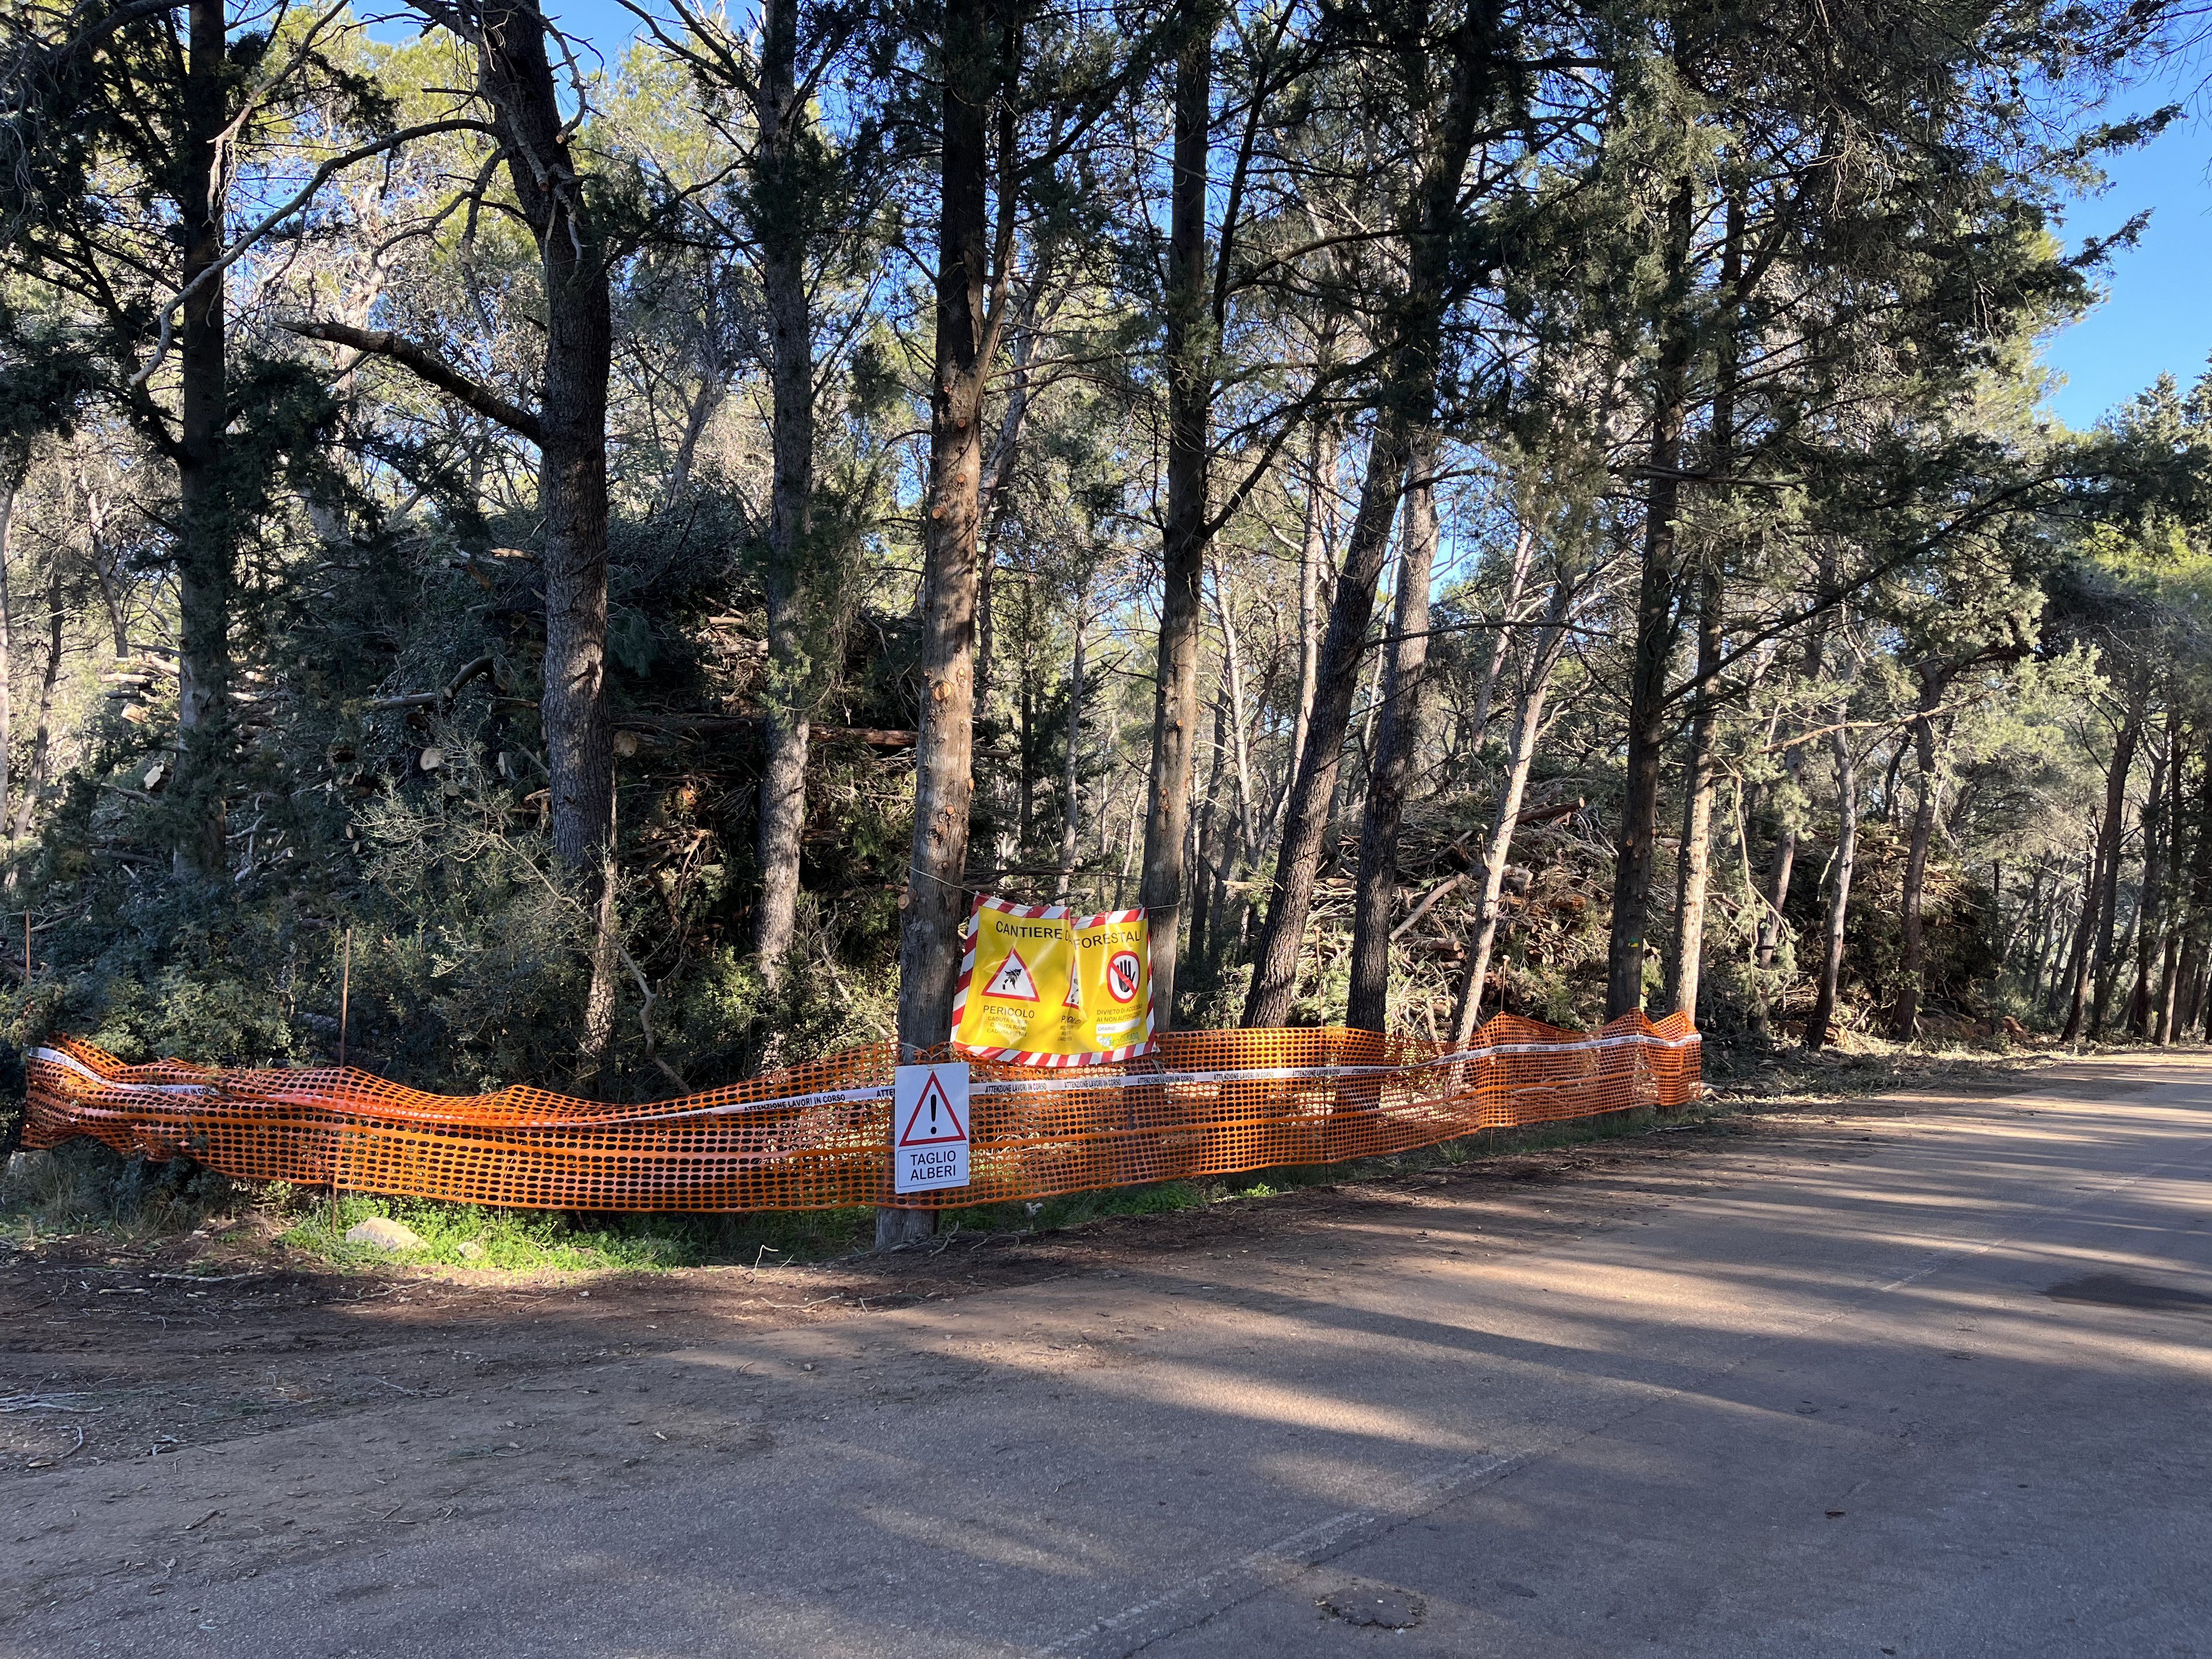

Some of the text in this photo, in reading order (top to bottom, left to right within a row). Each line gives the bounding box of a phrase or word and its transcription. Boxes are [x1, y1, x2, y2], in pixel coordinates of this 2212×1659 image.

[996, 921, 1063, 939] CANTIERE
[983, 1005, 1035, 1018] PERICOLO
[1214, 1073, 1239, 1081] ATTENZIONE
[877, 1088, 895, 1098] ATTE
[985, 1085, 1011, 1093] ATTENZIONE
[744, 1102, 786, 1112] ATTENZIONE
[788, 1098, 812, 1108] LAVORI
[823, 1094, 845, 1104] CORSO
[910, 1150, 956, 1166] TAGLIO
[911, 1165, 956, 1181] ALBERI
